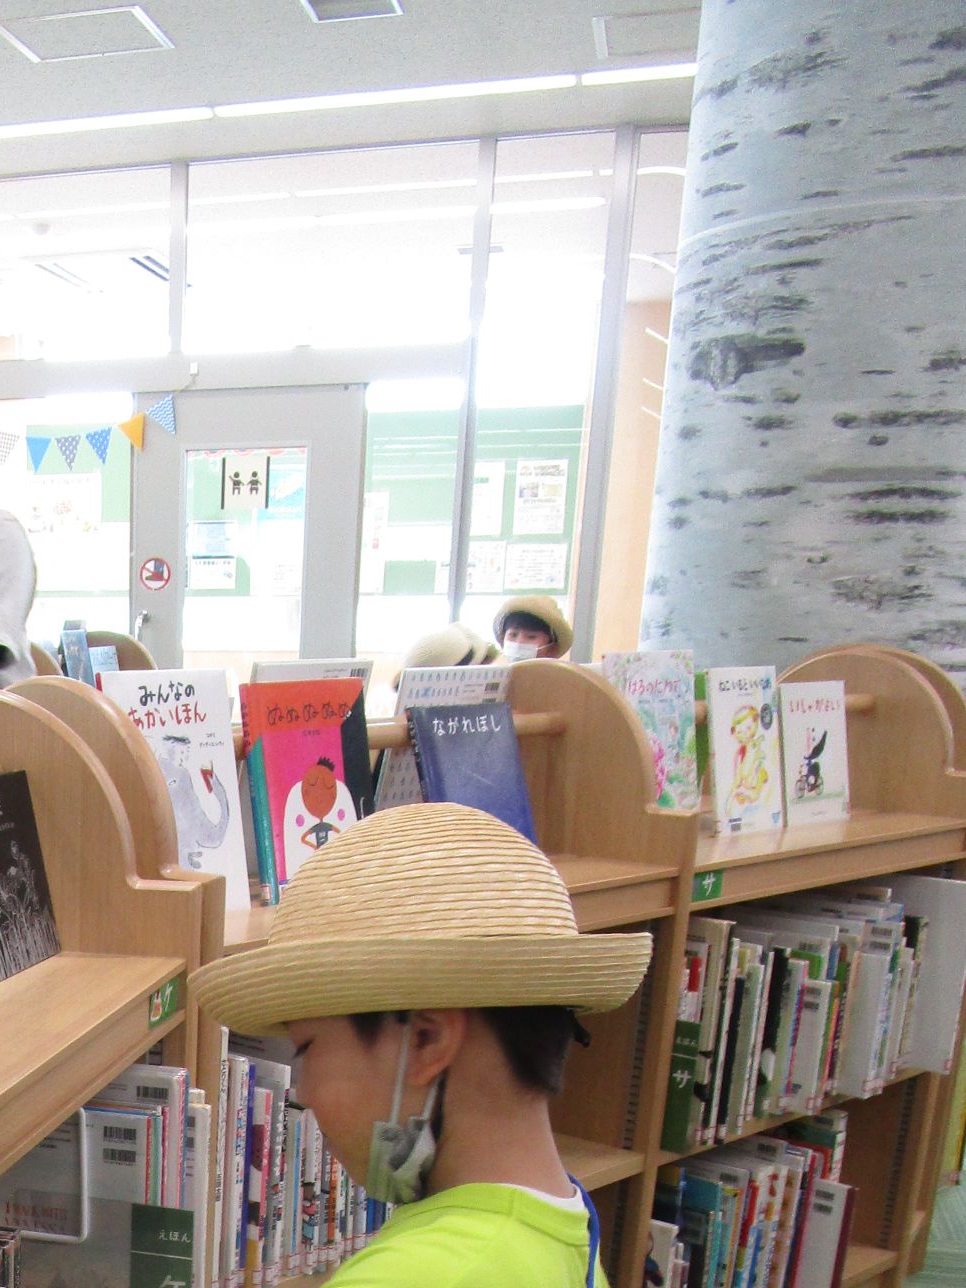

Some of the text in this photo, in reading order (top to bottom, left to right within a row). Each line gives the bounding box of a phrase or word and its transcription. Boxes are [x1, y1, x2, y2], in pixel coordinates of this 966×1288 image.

[137, 680, 195, 706] みんなの
[127, 701, 207, 730] あかいほん
[701, 874, 716, 897] サ
[672, 1069, 693, 1089] サ
[158, 1229, 193, 1245] えほん
